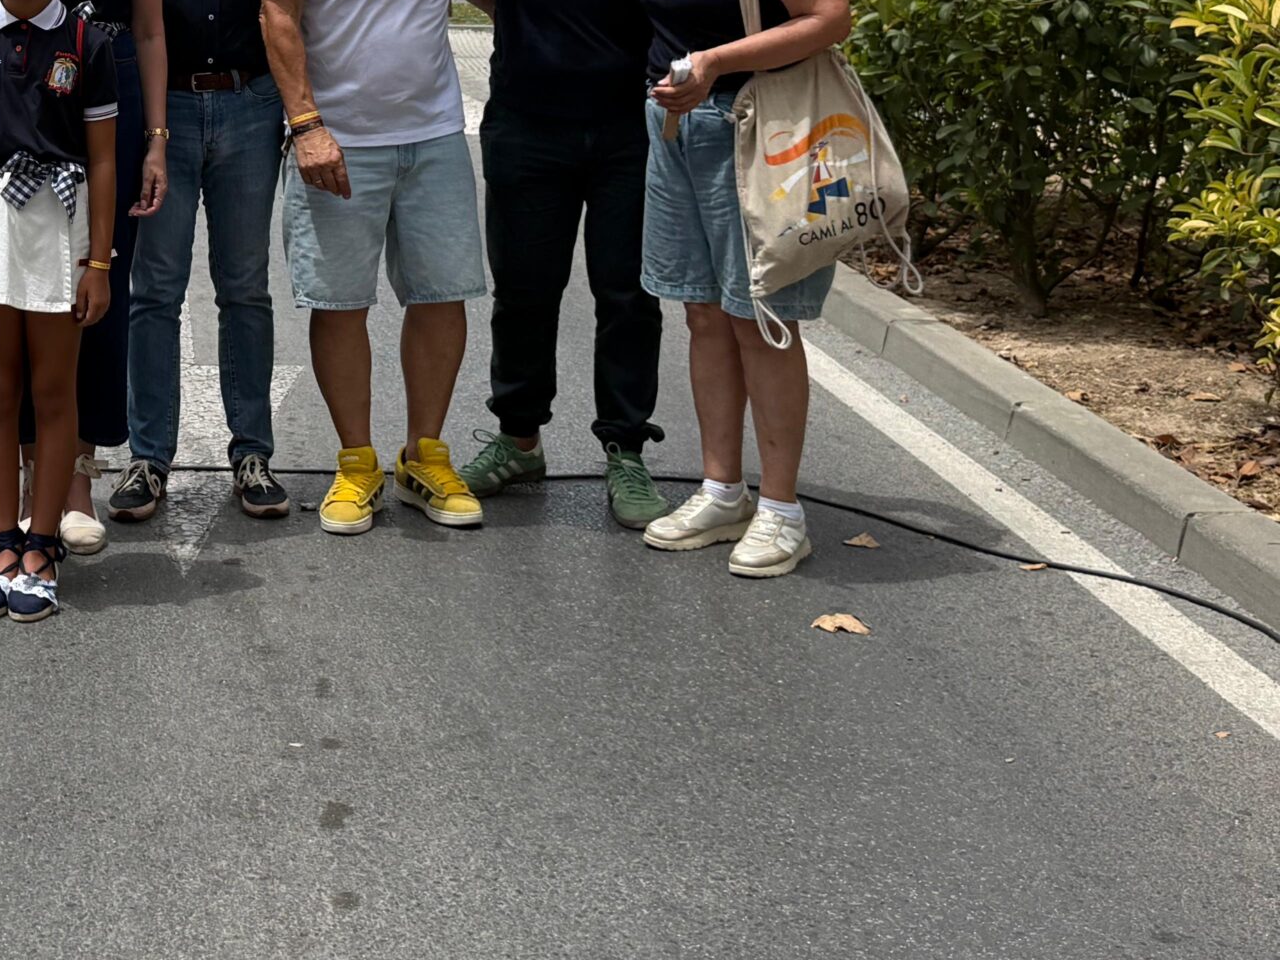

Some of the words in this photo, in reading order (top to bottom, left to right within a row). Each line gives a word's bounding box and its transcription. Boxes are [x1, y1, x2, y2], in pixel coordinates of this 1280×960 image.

[798, 220, 837, 246] CAMÍ
[841, 217, 854, 234] AL
[854, 196, 886, 227] 80
